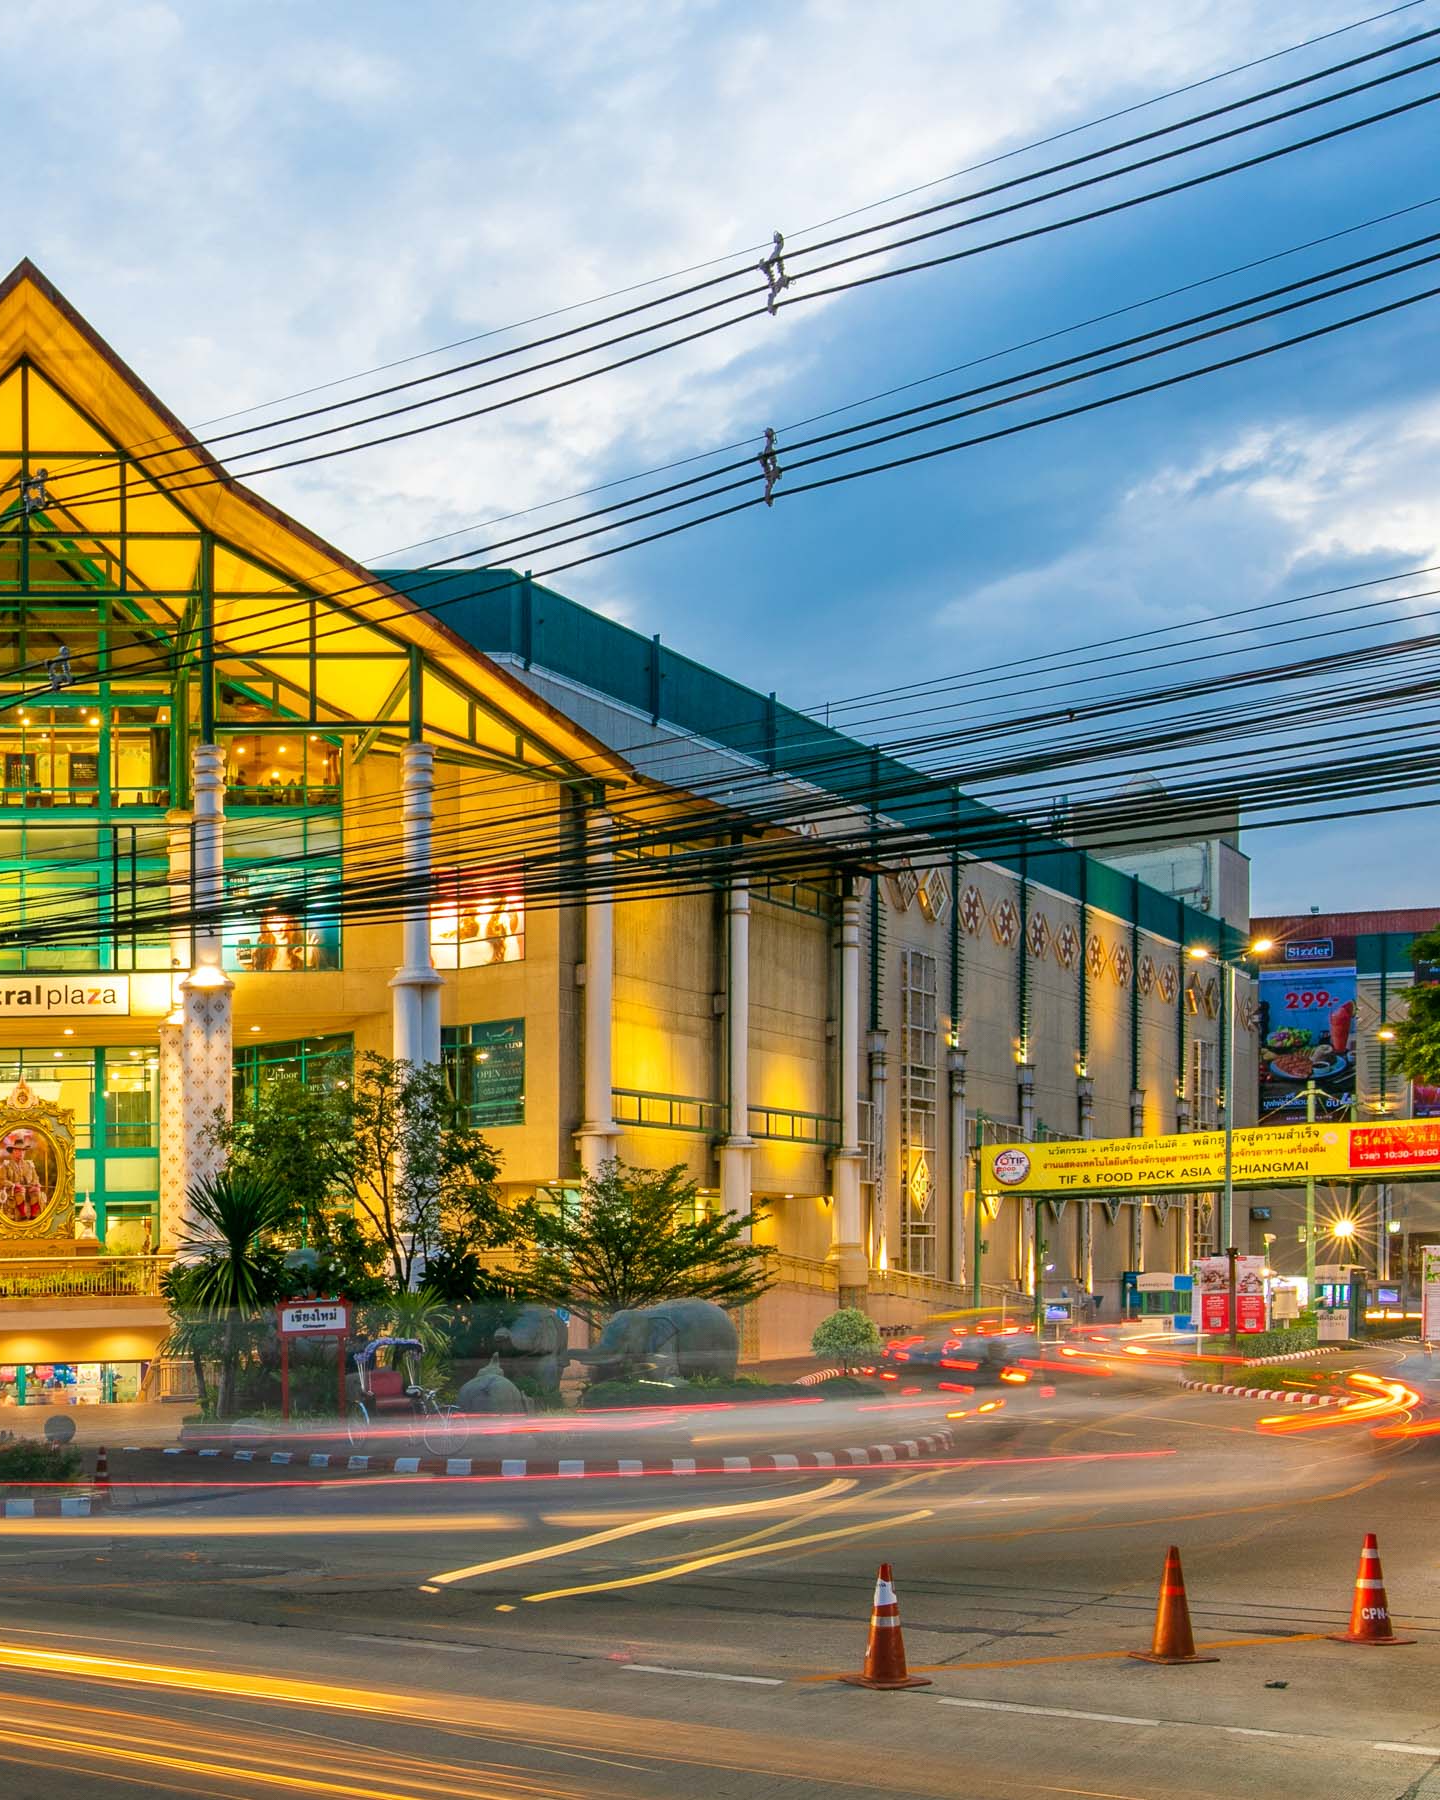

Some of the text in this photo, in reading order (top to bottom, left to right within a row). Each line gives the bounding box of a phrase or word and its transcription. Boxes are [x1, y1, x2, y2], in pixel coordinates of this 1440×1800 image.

[1288, 946, 1330, 958] Sizzler
[48, 985, 116, 1010] plaza
[1285, 992, 1339, 1010] 299.-
[477, 1070, 501, 1079] OPEN
[1193, 1126, 1320, 1148] พลิกธุกิจสู่ความสำเร็จ
[1354, 1135, 1369, 1146] 31
[1059, 1175, 1078, 1185] TIF
[1082, 1174, 1091, 1184] &
[1096, 1172, 1134, 1183] FOOD
[1138, 1169, 1175, 1180] PACK
[1180, 1167, 1212, 1177] ASIA
[291, 1308, 337, 1323] เชียงใหม่
